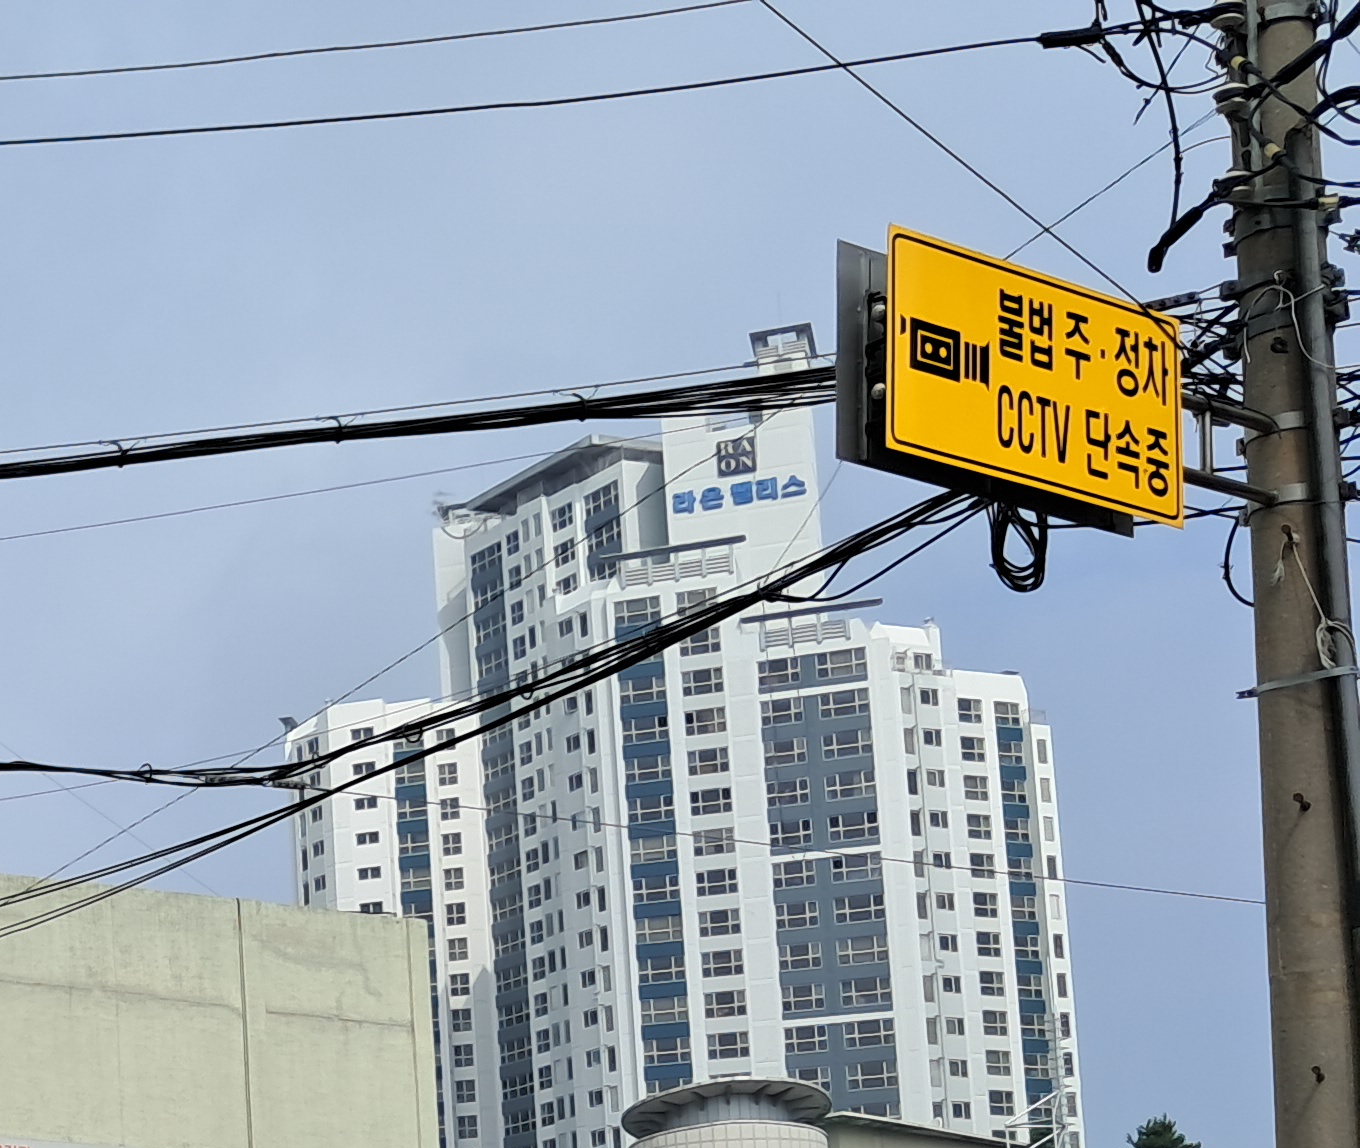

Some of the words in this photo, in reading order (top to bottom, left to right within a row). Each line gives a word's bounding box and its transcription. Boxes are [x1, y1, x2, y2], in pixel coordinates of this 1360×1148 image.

[997, 288, 1054, 372] 불법
[1064, 312, 1169, 406] 주·정차
[720, 456, 753, 473] ON
[997, 385, 1071, 464] CCTV
[1084, 407, 1170, 498] 단속중
[672, 487, 725, 514] 라온
